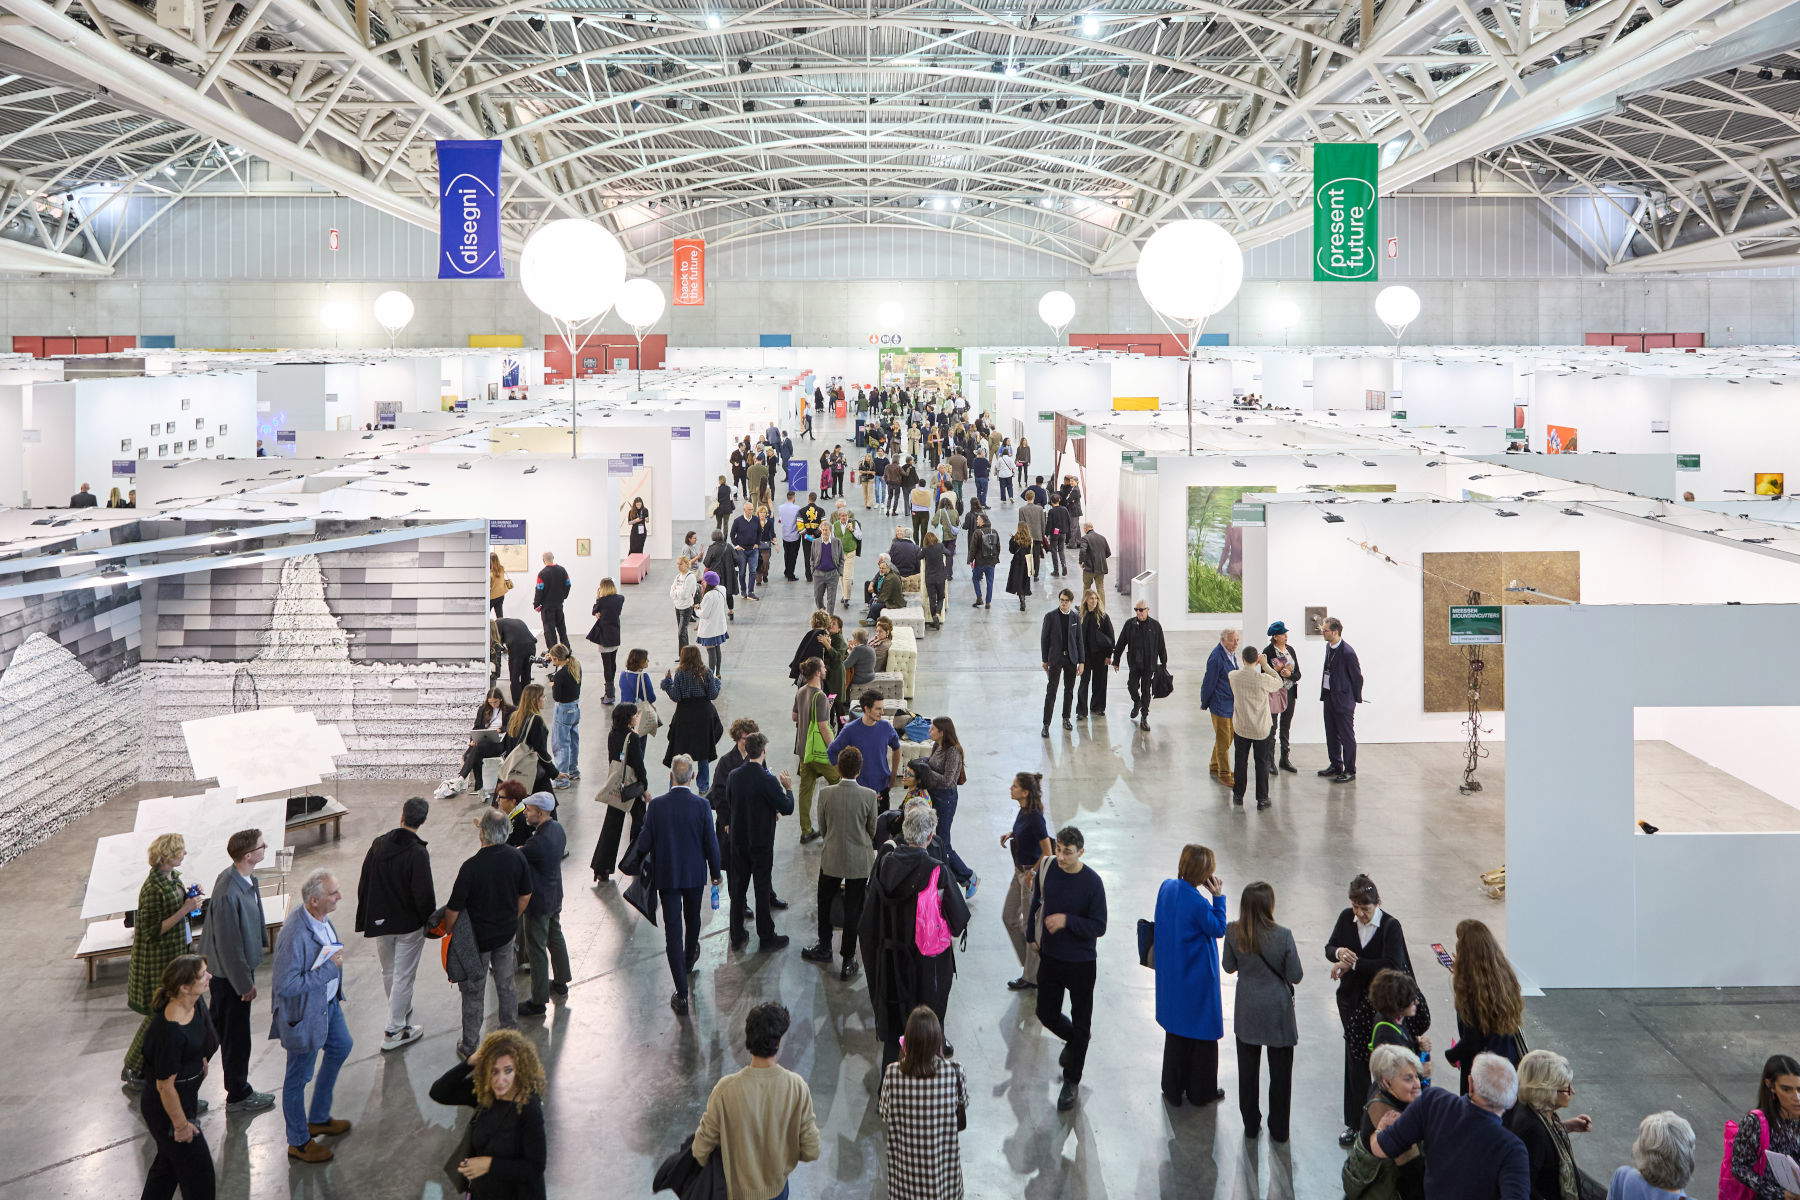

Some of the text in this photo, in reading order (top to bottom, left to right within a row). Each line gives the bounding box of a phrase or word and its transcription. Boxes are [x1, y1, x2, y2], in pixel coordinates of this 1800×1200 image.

[459, 189, 481, 264] disegni
[1328, 188, 1347, 267] present
[1347, 206, 1364, 268] future
[680, 261, 689, 299] back to
[689, 250, 698, 299] the future
